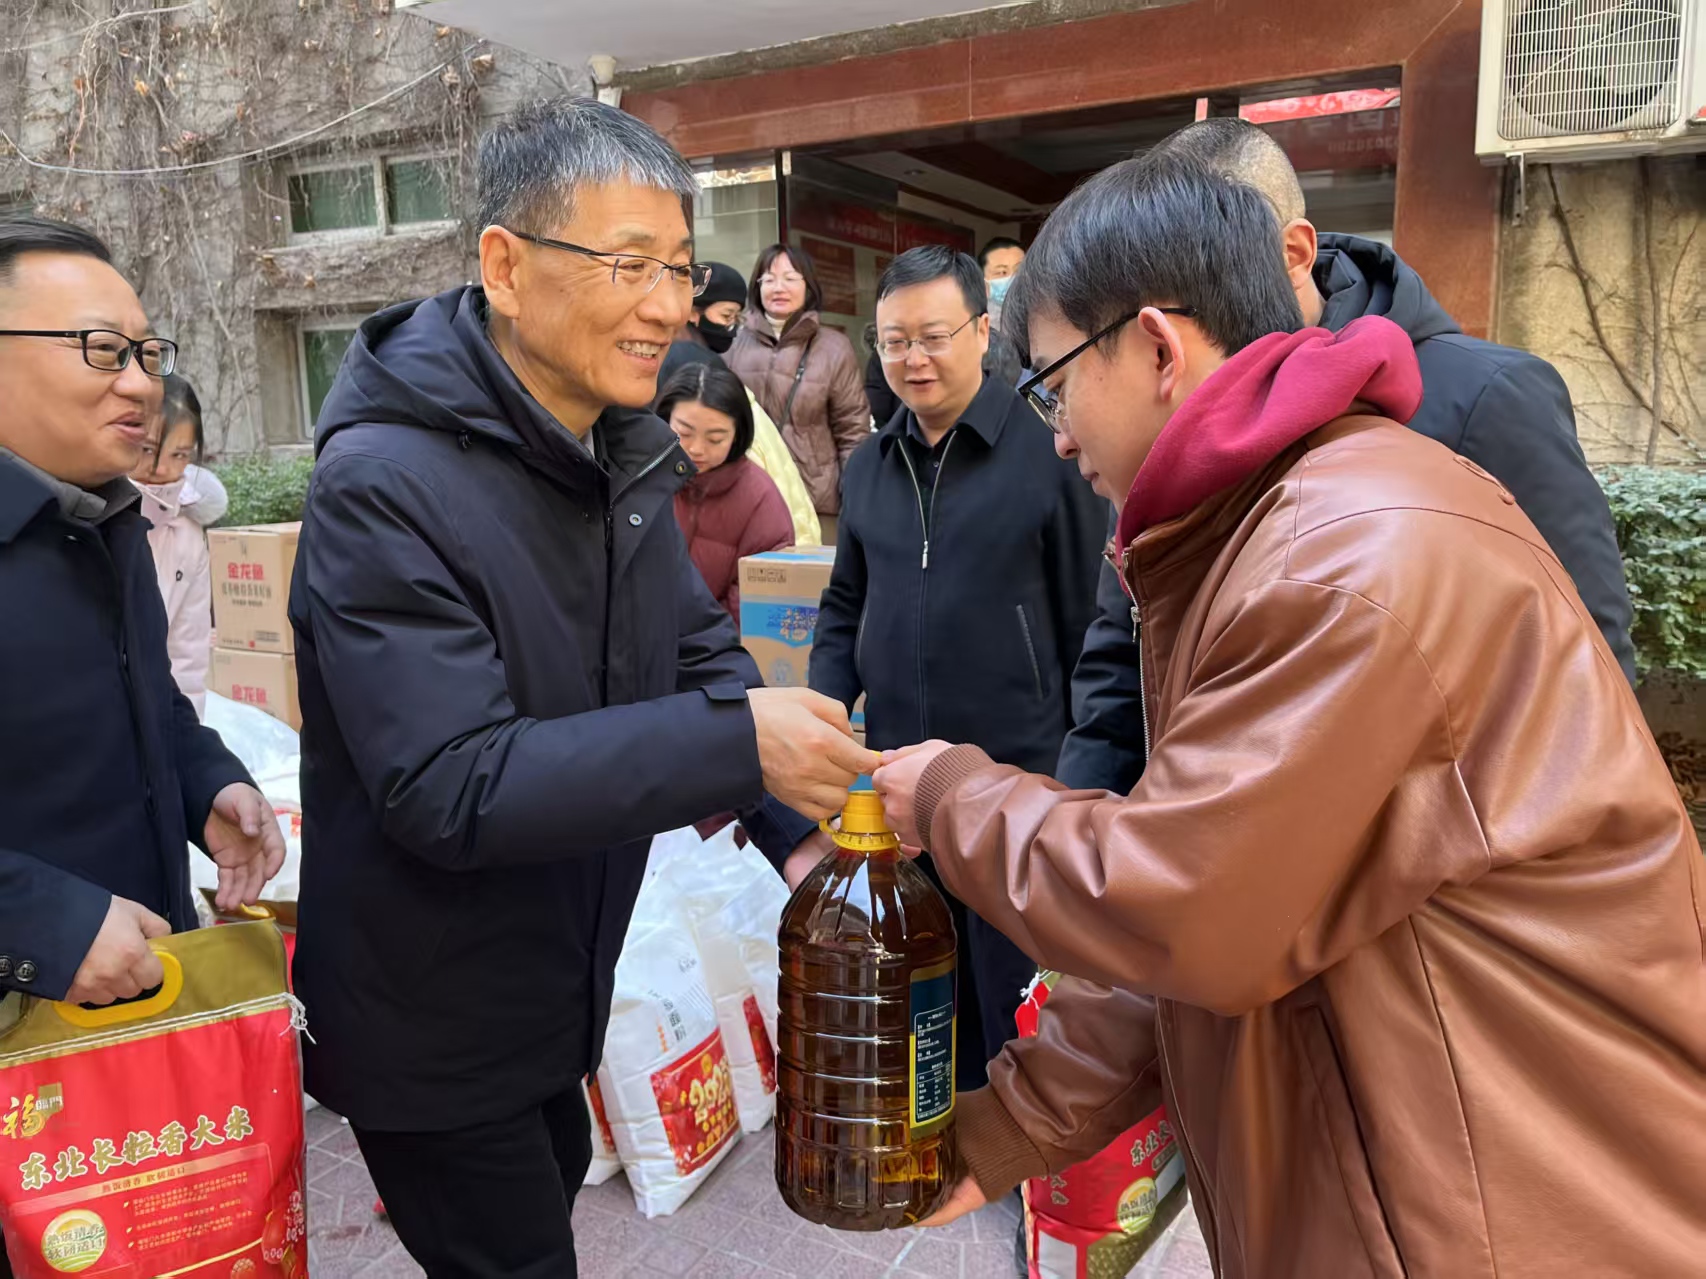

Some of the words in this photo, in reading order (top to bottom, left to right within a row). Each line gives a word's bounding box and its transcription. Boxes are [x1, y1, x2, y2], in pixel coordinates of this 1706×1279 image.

[19, 1105, 253, 1191] 东北长粒香大米
